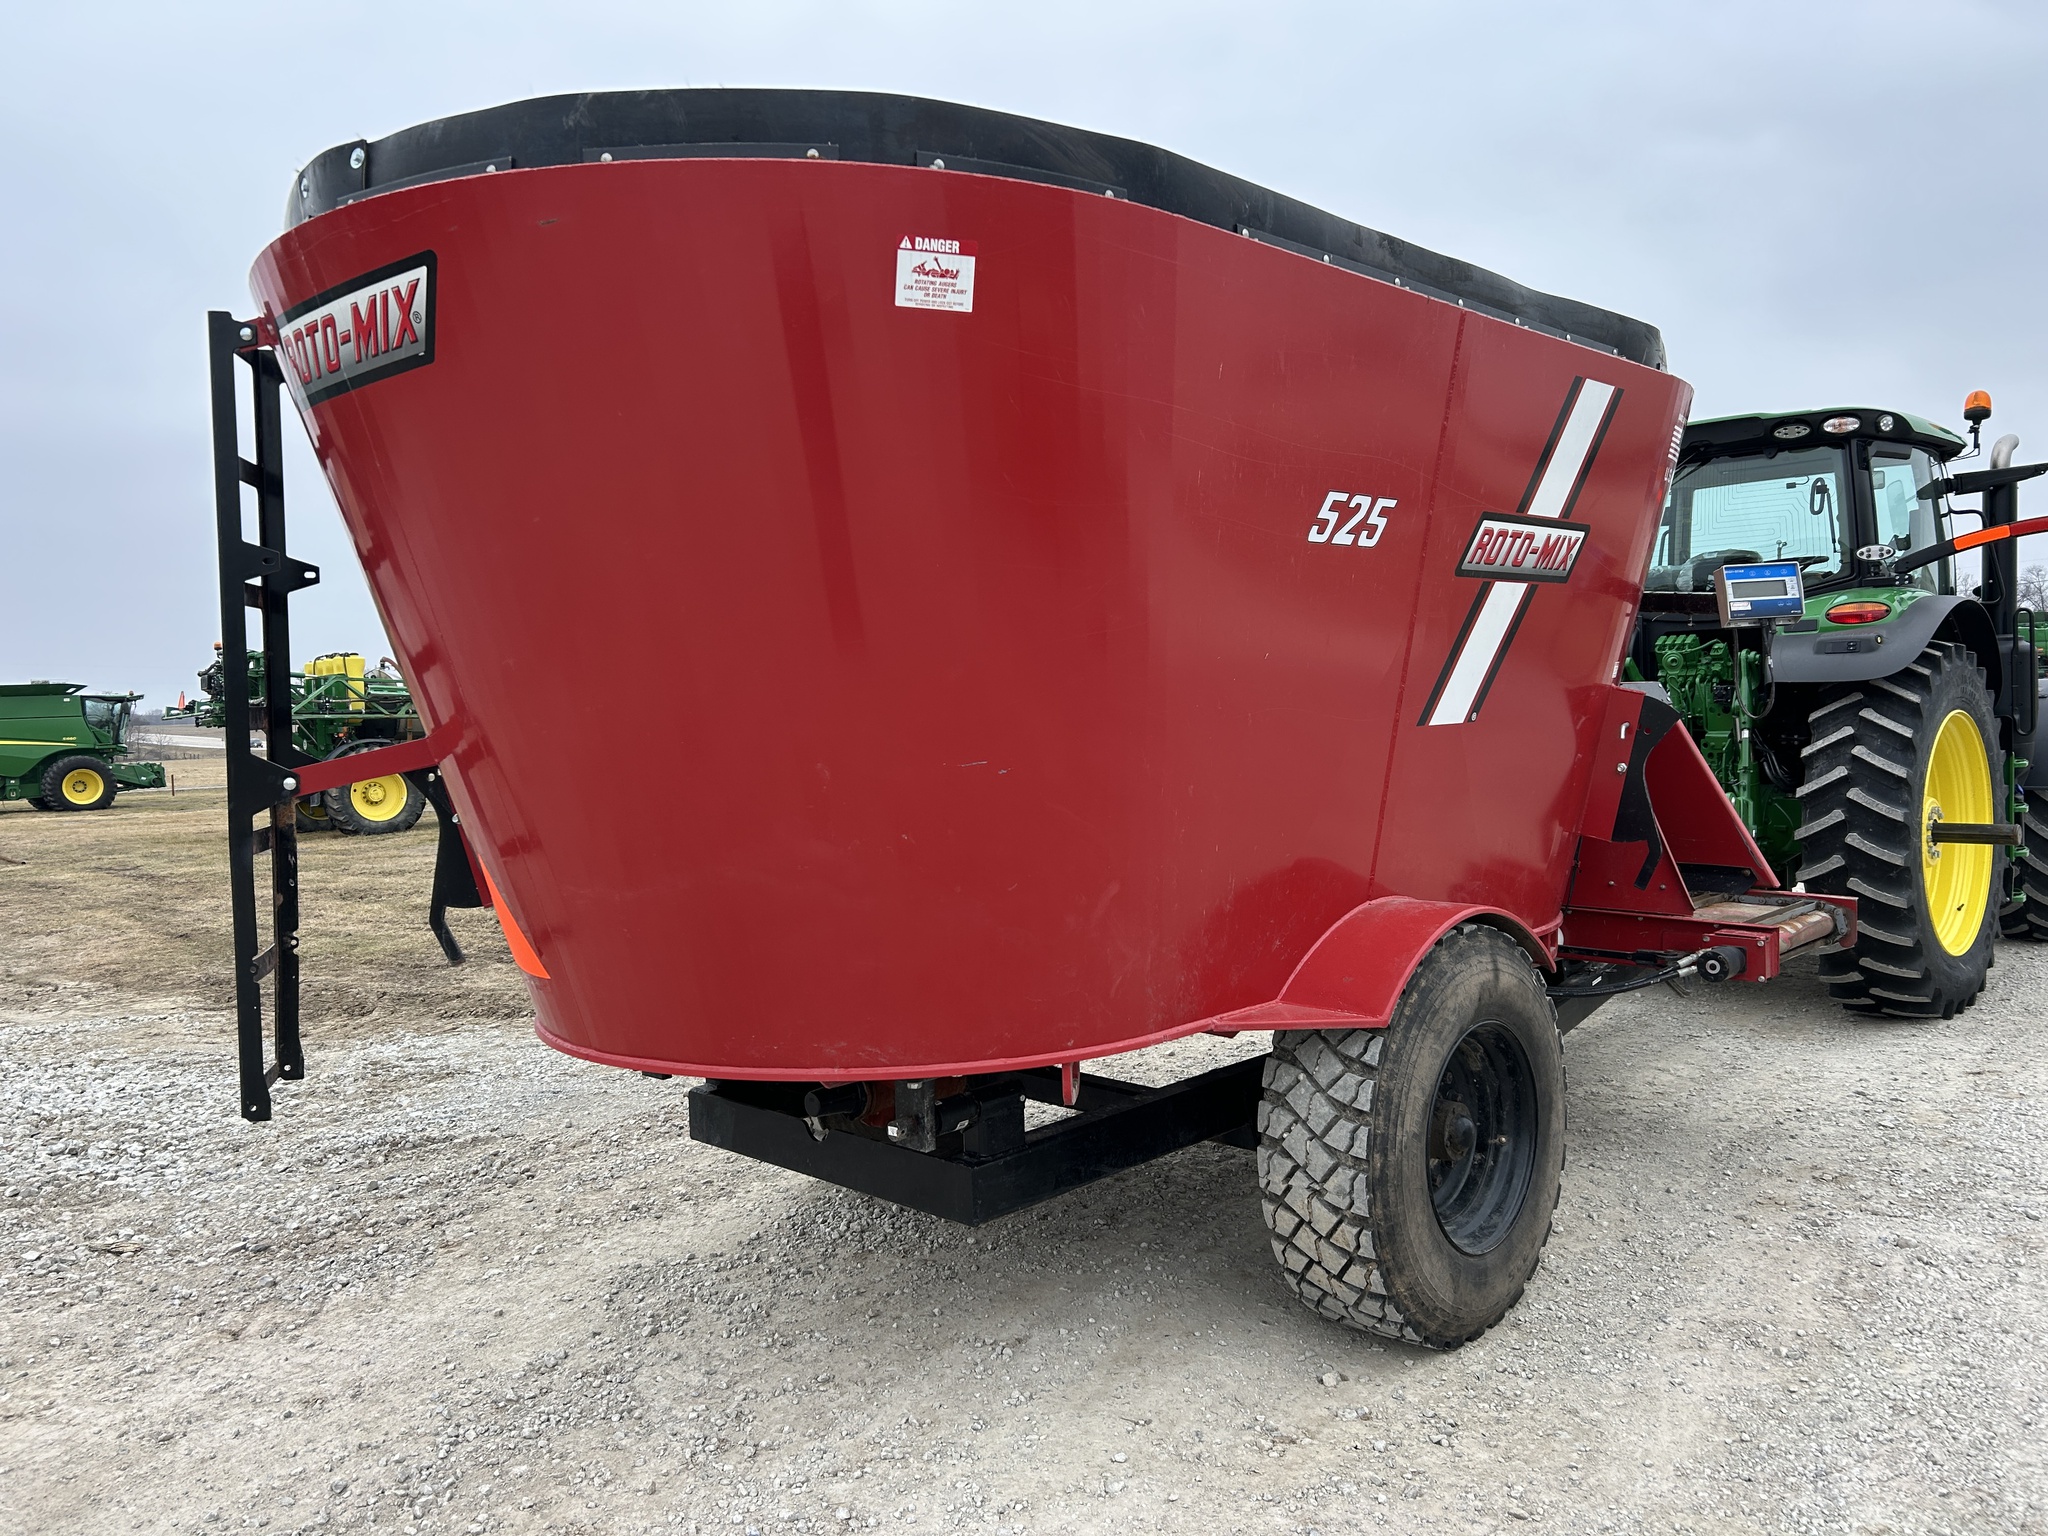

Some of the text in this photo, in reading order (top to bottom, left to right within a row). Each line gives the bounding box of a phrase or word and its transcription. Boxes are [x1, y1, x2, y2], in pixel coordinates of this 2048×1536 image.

[915, 236, 960, 254] DANGER
[283, 278, 421, 385] ROTO-MIX
[1307, 490, 1399, 548] 525
[1467, 527, 1581, 571] ROTO-MIX
